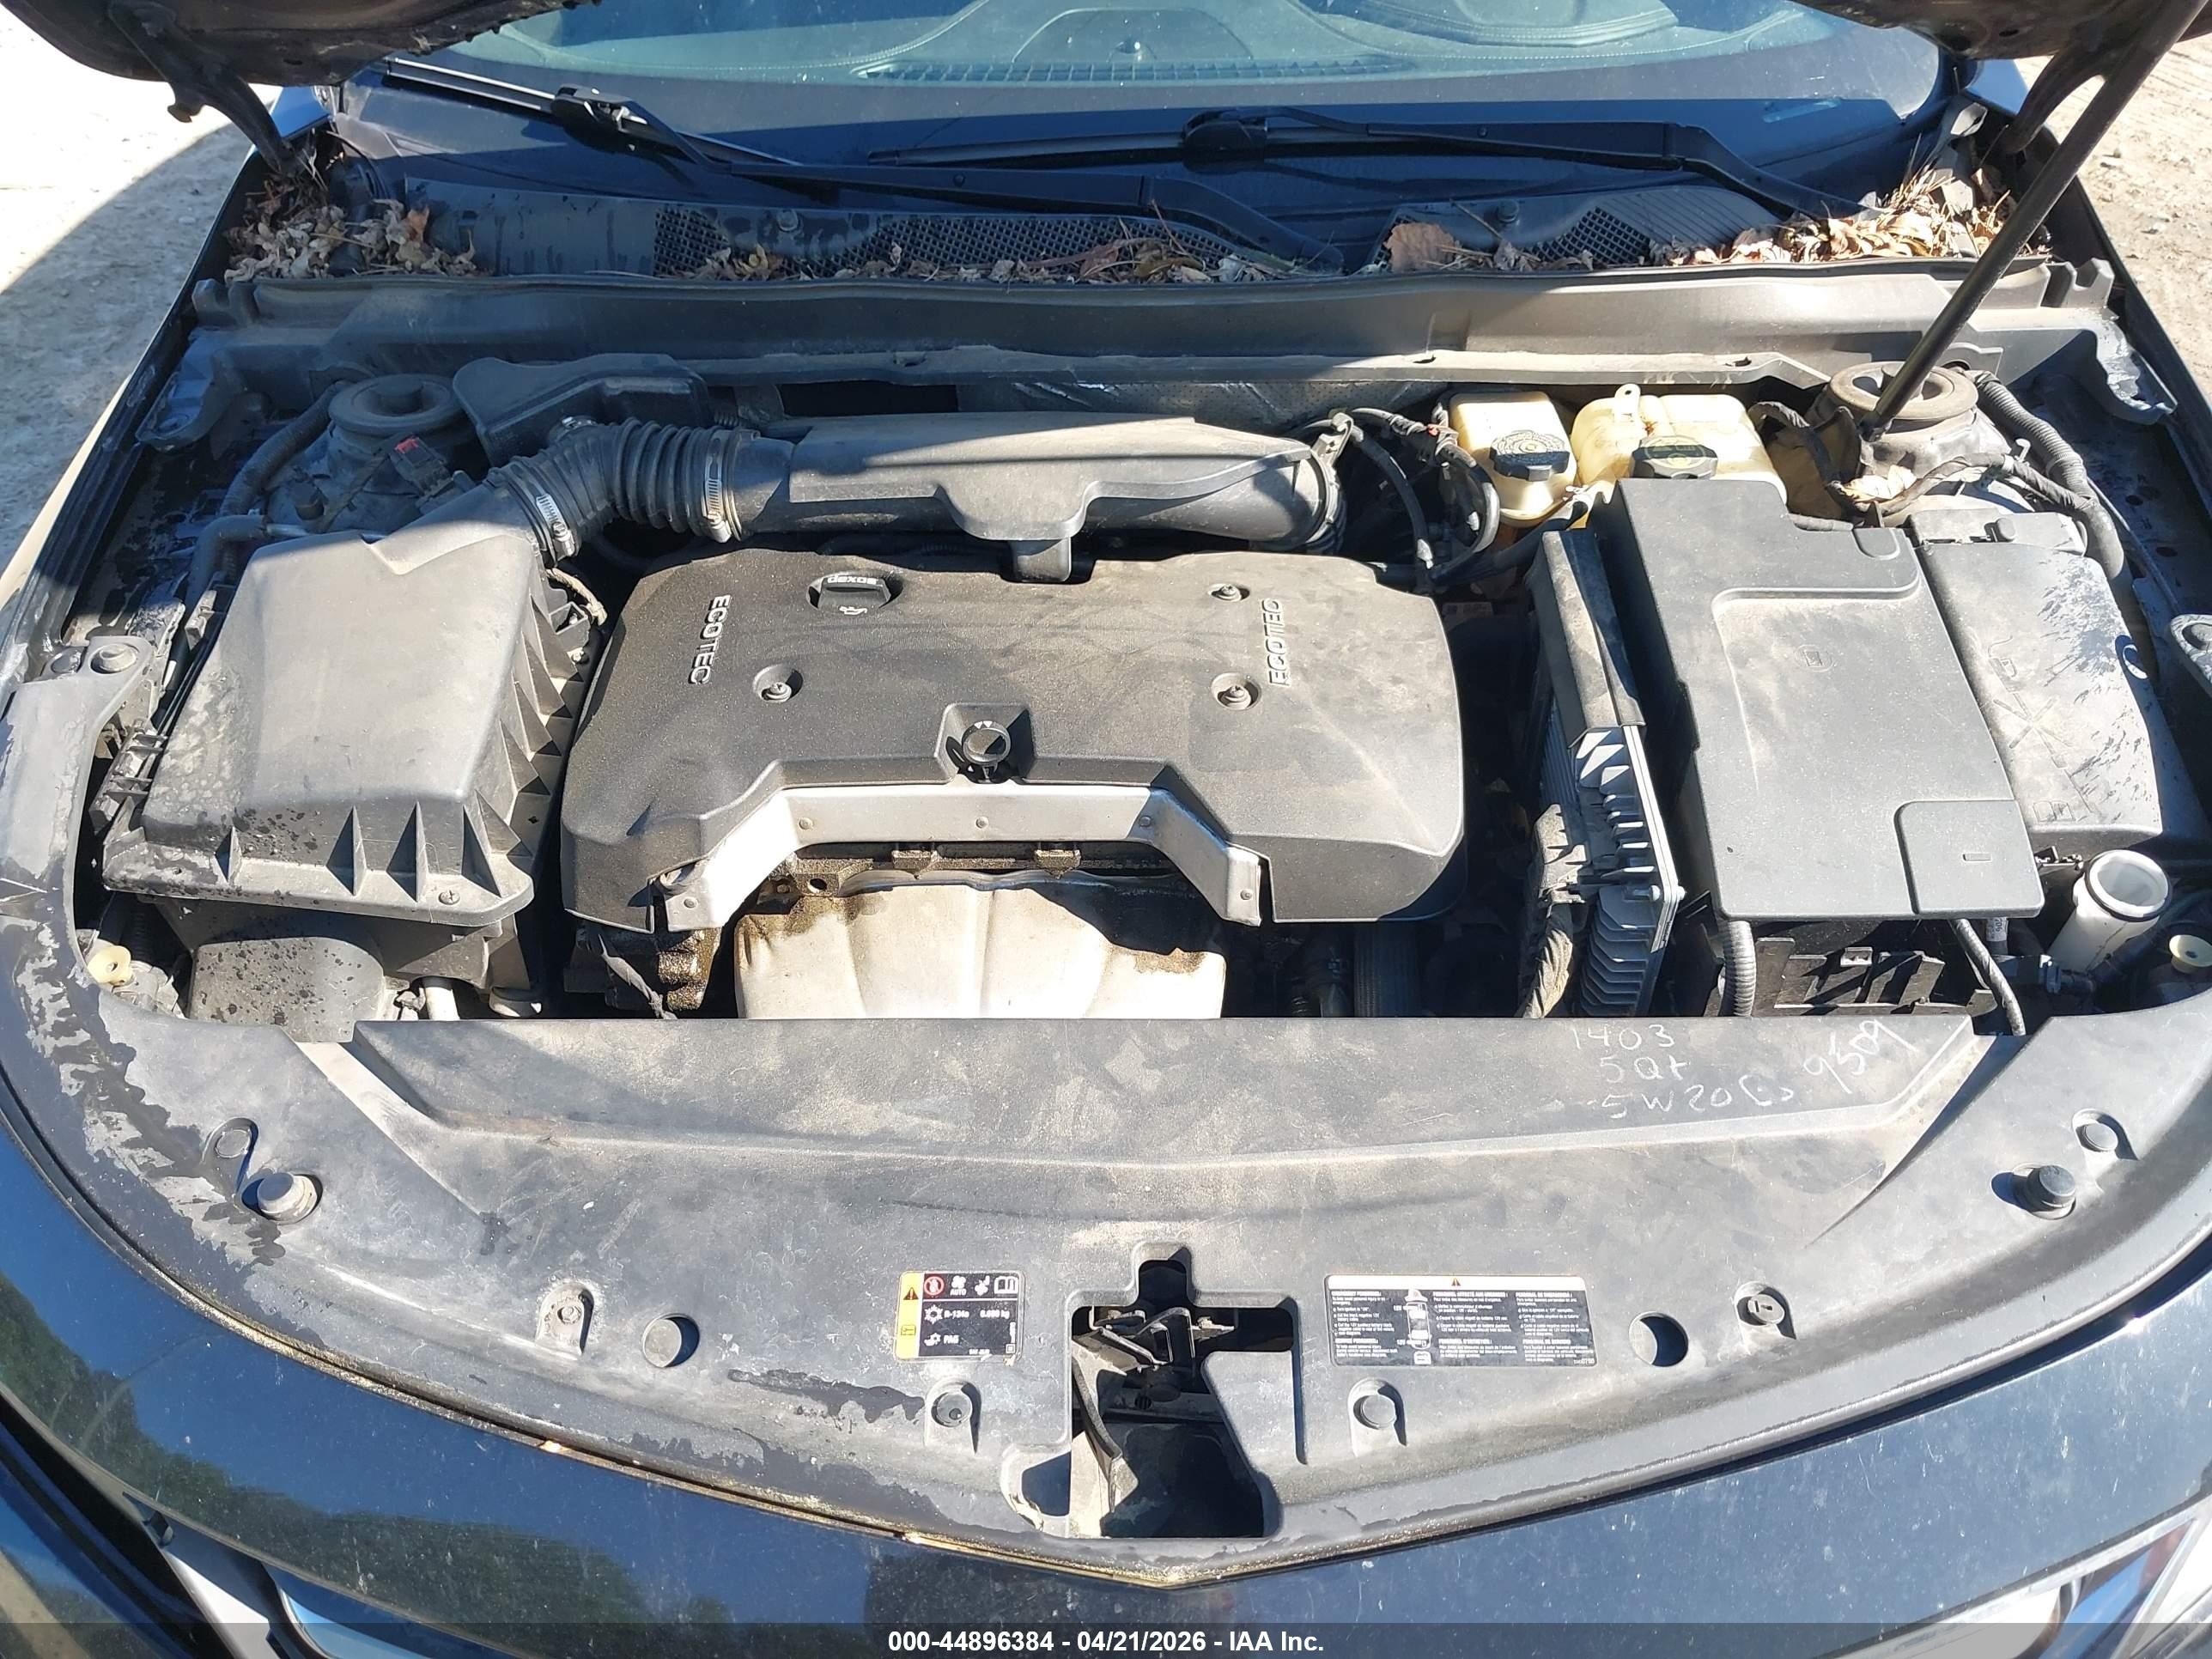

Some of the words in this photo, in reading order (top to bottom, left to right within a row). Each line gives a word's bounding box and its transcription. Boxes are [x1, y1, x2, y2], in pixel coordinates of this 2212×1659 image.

[827, 574, 877, 585] dexos
[689, 594, 731, 685] ECOTEC
[1261, 598, 1291, 686] ECOTEC
[1572, 1024, 1675, 1050] 1403
